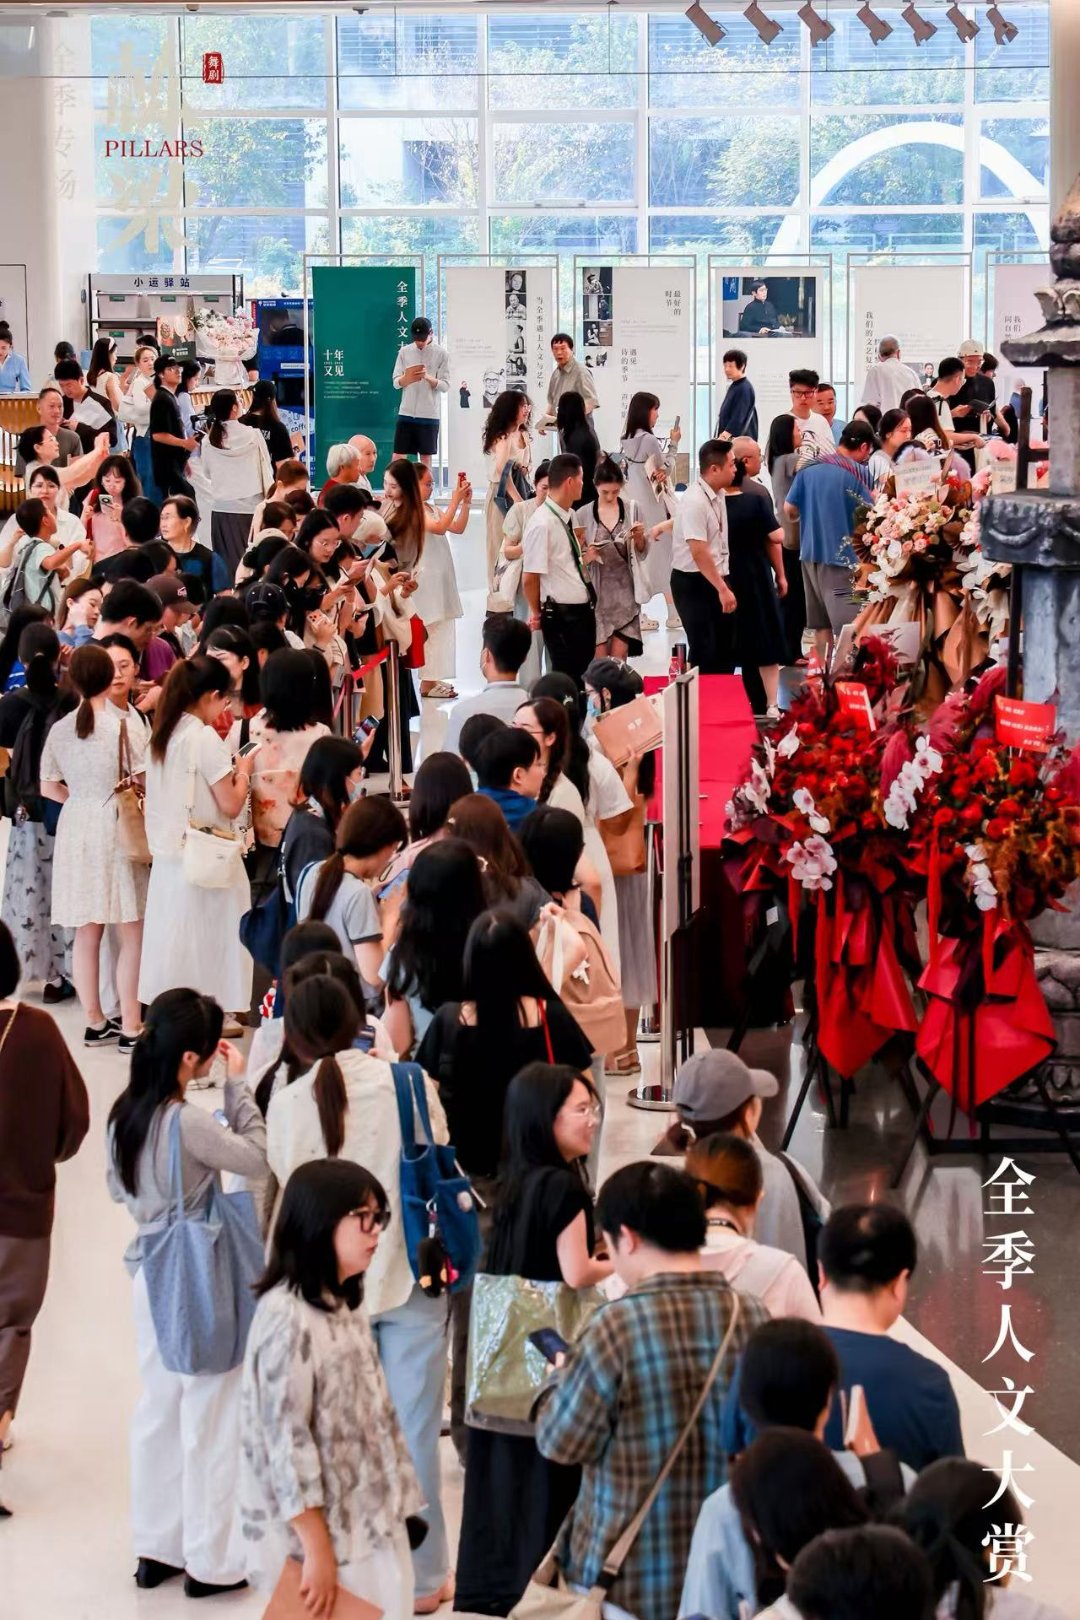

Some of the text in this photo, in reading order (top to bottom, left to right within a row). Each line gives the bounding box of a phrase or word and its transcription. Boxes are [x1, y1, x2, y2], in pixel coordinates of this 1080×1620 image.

[133, 276, 191, 289] 小运驿站
[664, 289, 673, 307] 时节
[673, 289, 682, 316] 最好的
[322, 349, 345, 361] 十年
[323, 365, 345, 377] 又见
